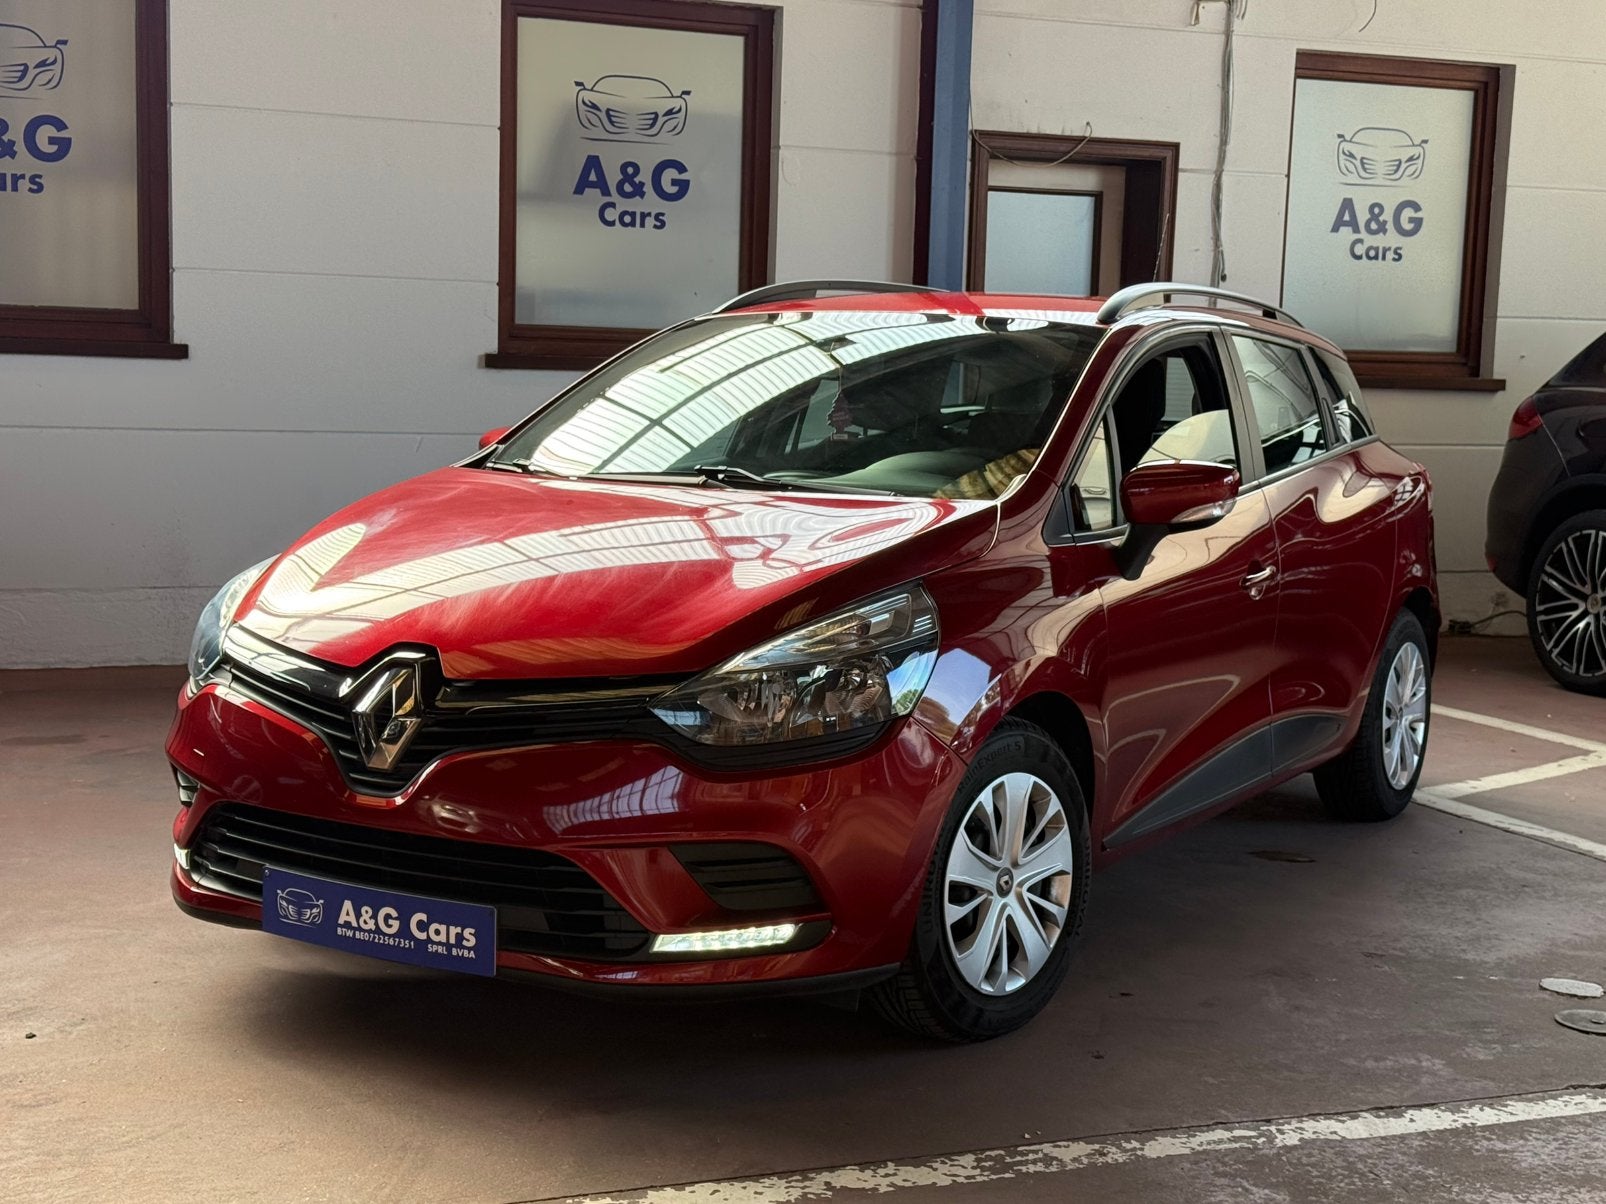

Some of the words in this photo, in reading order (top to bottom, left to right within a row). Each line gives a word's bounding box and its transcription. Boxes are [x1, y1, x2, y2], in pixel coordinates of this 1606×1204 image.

[572, 154, 691, 202] A&G
[598, 201, 667, 230] Cars
[1330, 197, 1424, 238] A&G
[1349, 238, 1403, 262] Cars
[337, 899, 400, 934] A&G
[409, 912, 477, 947] Cars
[337, 927, 354, 937] BTW
[355, 930, 415, 949] BE0722567351
[427, 943, 448, 954] SPRL
[451, 947, 475, 959] BVBA
